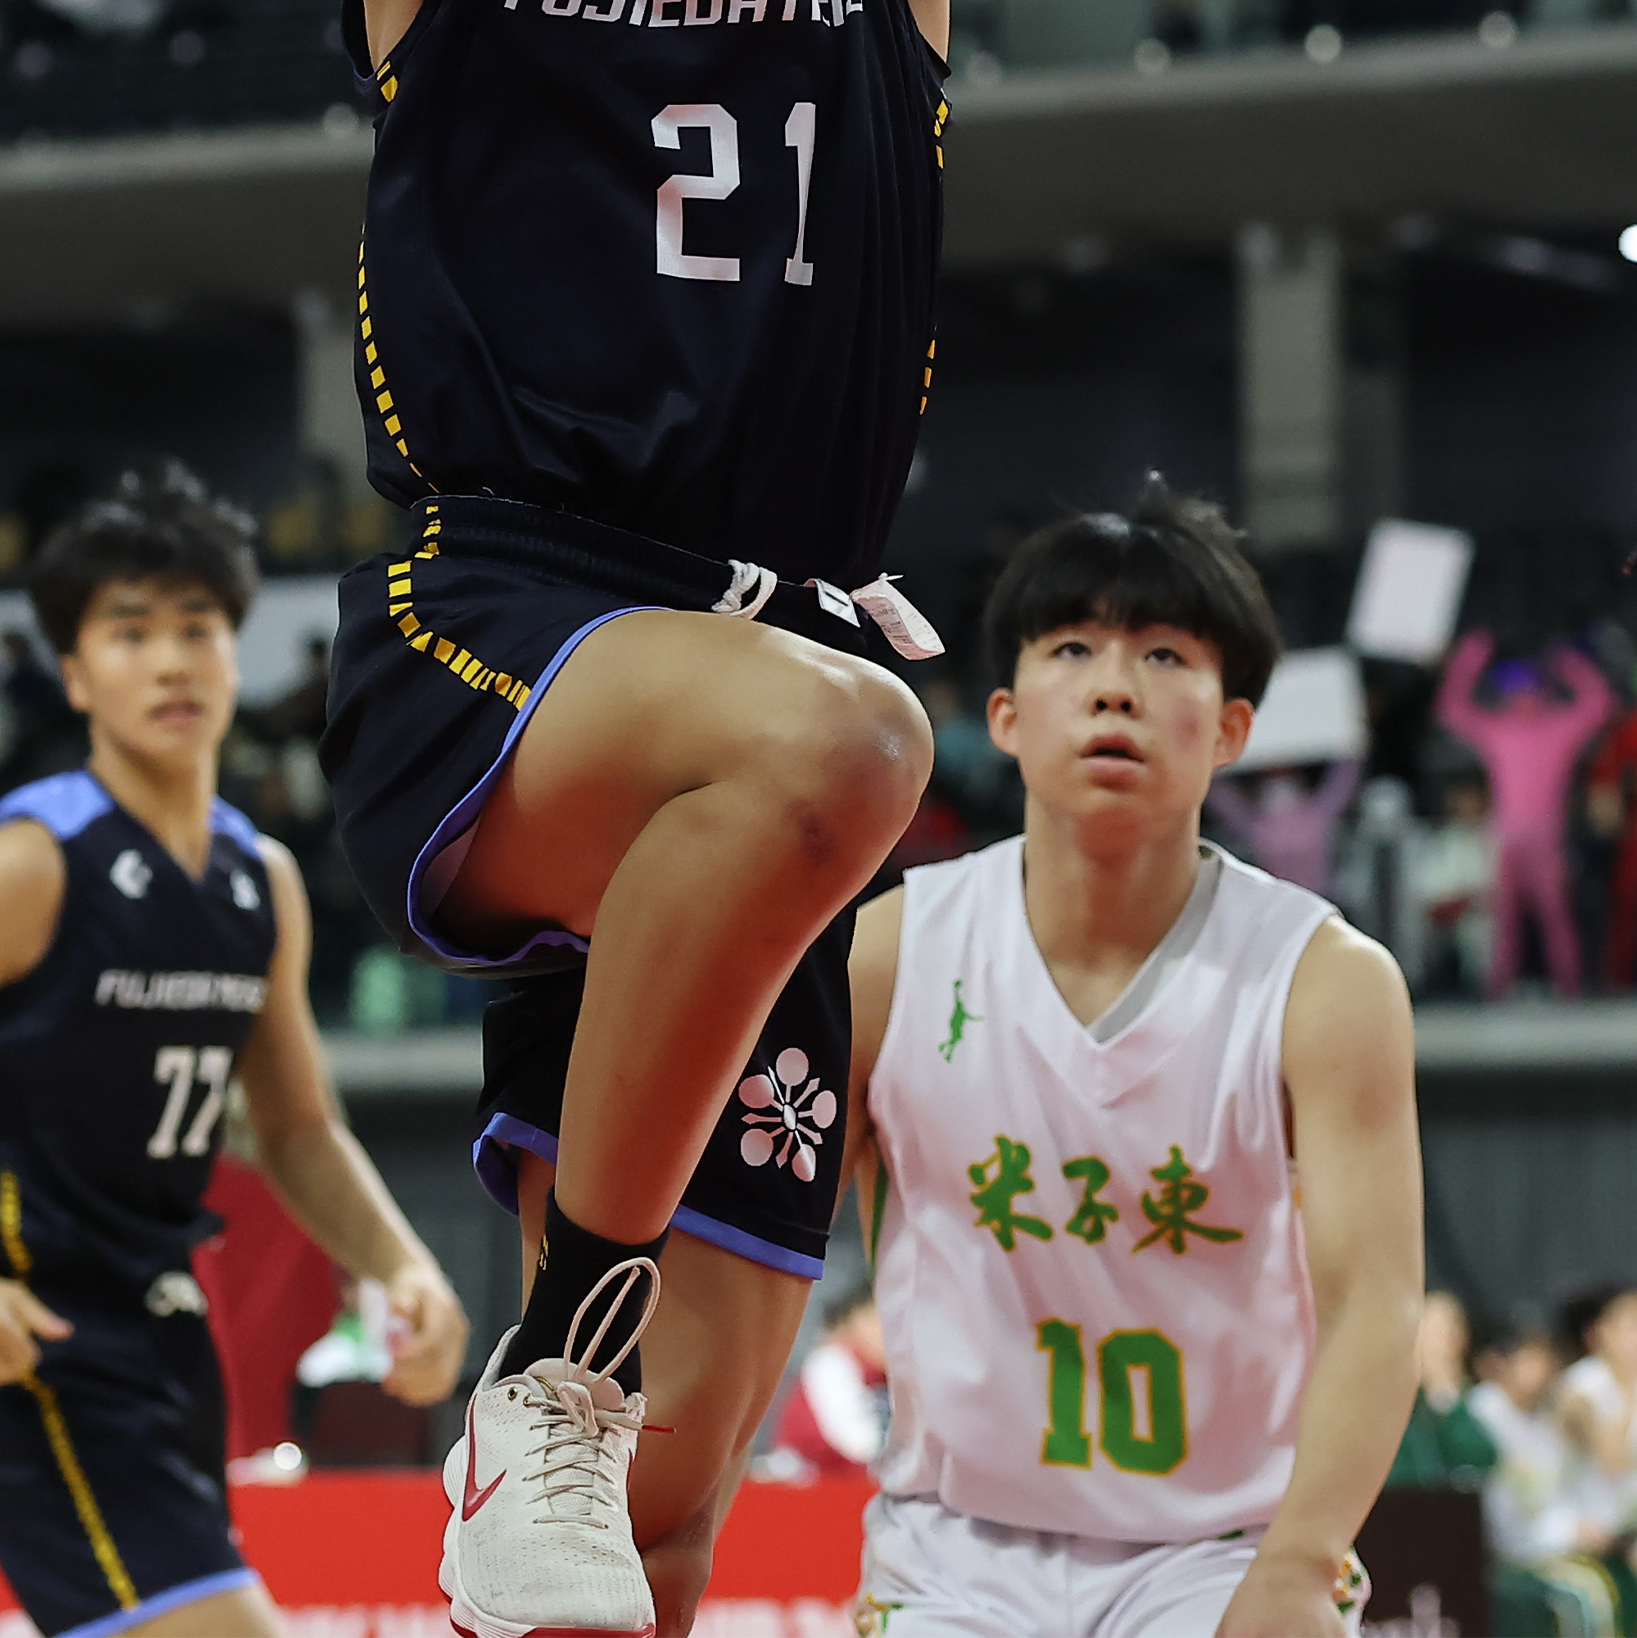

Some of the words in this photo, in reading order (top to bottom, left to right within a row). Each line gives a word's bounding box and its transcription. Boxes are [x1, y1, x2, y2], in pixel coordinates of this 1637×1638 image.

[650, 101, 817, 287] 21
[146, 1044, 234, 1159] 77
[967, 1133, 1245, 1256] 米子東
[1035, 1316, 1190, 1477] 10
